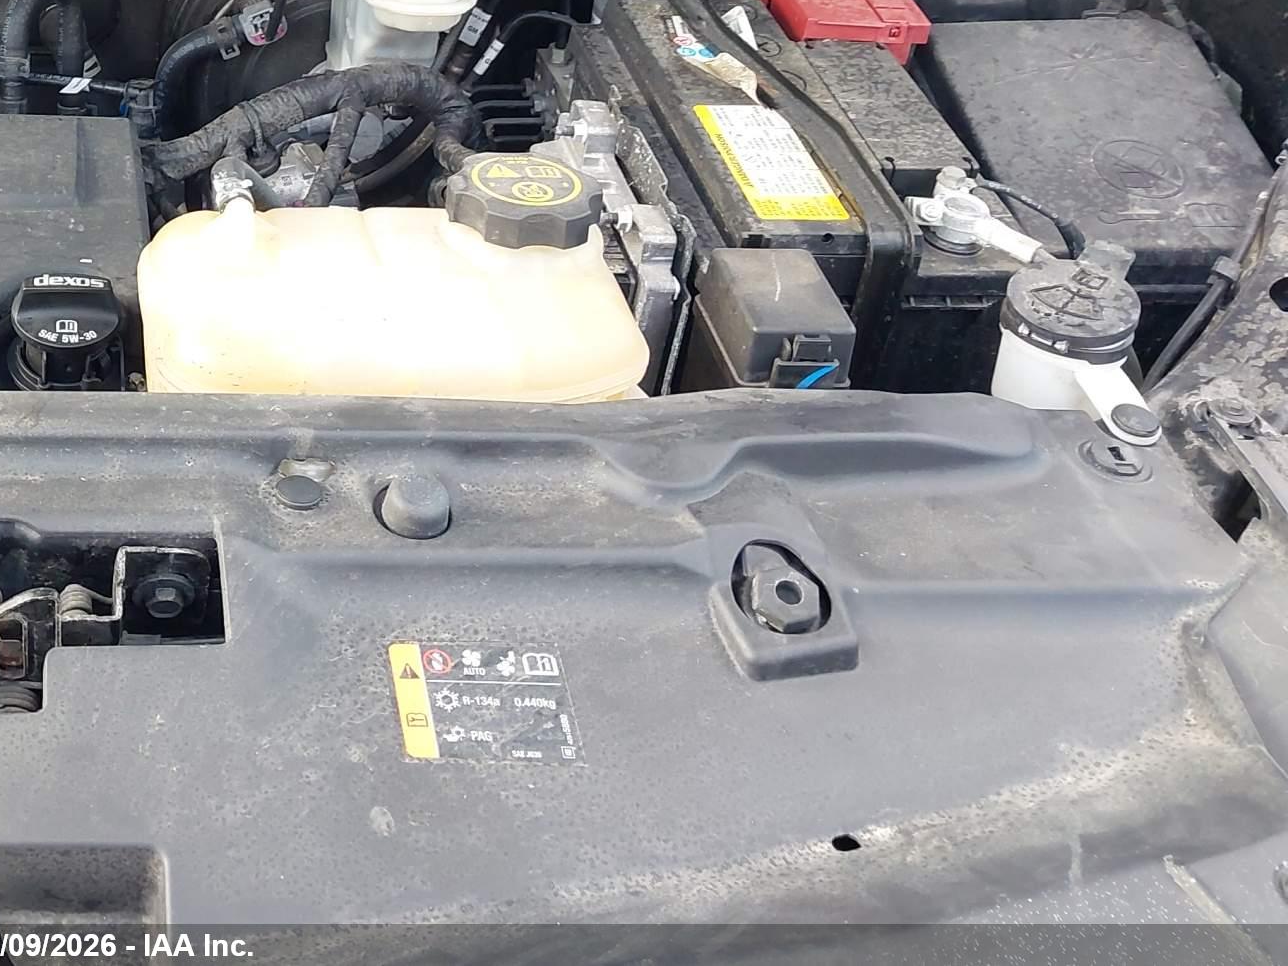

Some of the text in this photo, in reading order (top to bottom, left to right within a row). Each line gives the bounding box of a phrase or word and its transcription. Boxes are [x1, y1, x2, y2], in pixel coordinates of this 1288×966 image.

[33, 273, 107, 288] dexos
[38, 329, 98, 343] SAE 5W-30
[463, 667, 487, 676] AUTO
[462, 695, 501, 708] R-134a
[470, 730, 493, 742] PAG
